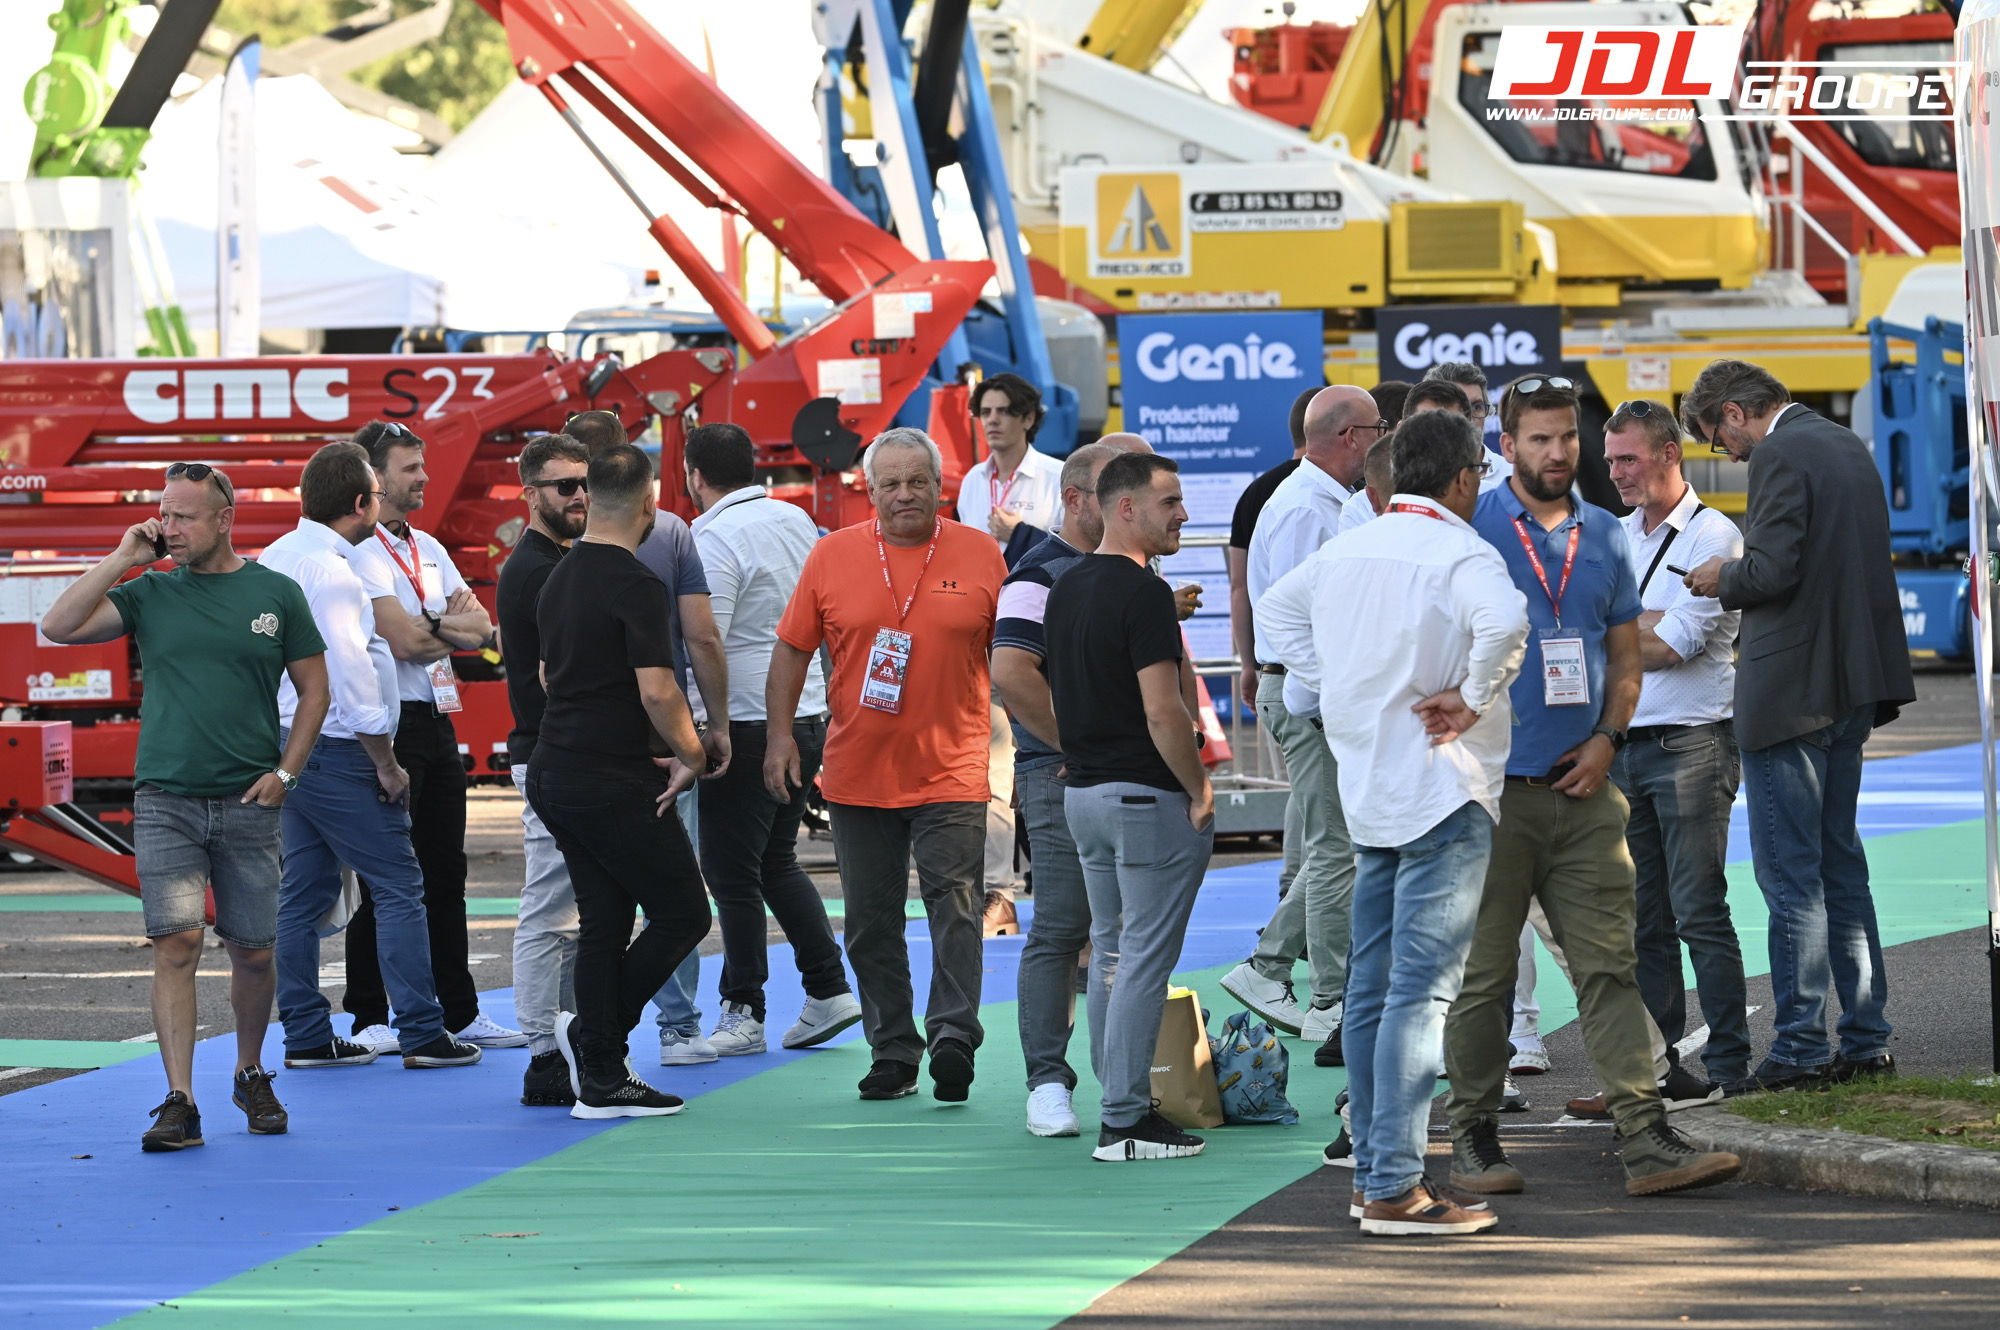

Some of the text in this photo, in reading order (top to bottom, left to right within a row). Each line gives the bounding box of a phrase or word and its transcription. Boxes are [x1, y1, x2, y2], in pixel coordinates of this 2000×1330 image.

[382, 366, 496, 420] S23
[1139, 403, 1240, 425] Productivité
[1140, 424, 1231, 444] en hauteur
[880, 628, 912, 640] INVITATION
[1545, 658, 1580, 666] BIENVENUE
[866, 697, 896, 709] VISITEUR
